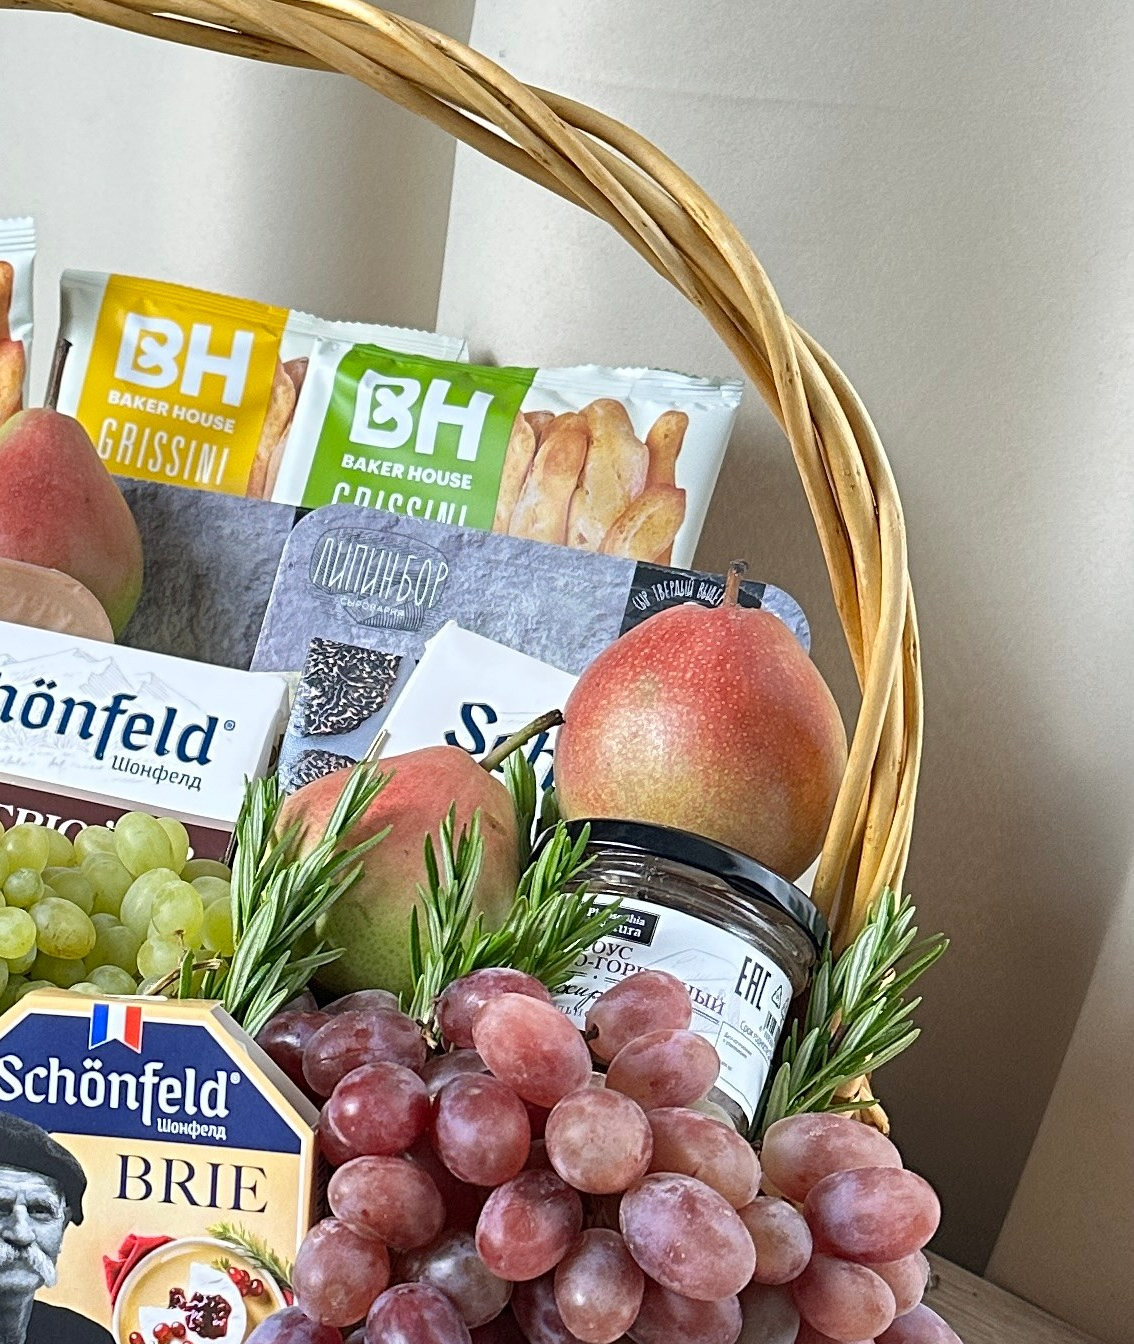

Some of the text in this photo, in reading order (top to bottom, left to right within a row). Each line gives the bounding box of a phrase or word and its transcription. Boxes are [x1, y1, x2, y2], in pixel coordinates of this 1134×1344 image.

[114, 312, 255, 408] BH
[107, 390, 236, 434] BAKER HOUSE
[349, 369, 495, 462] BH
[97, 417, 230, 486] GRISSINI
[341, 454, 473, 490] BAKER HOUSE
[111, 755, 203, 792] Шонфелд
[586, 940, 634, 961] ОУС
[157, 1117, 227, 1141] Шонфелд
[113, 1153, 269, 1214] BRIE
